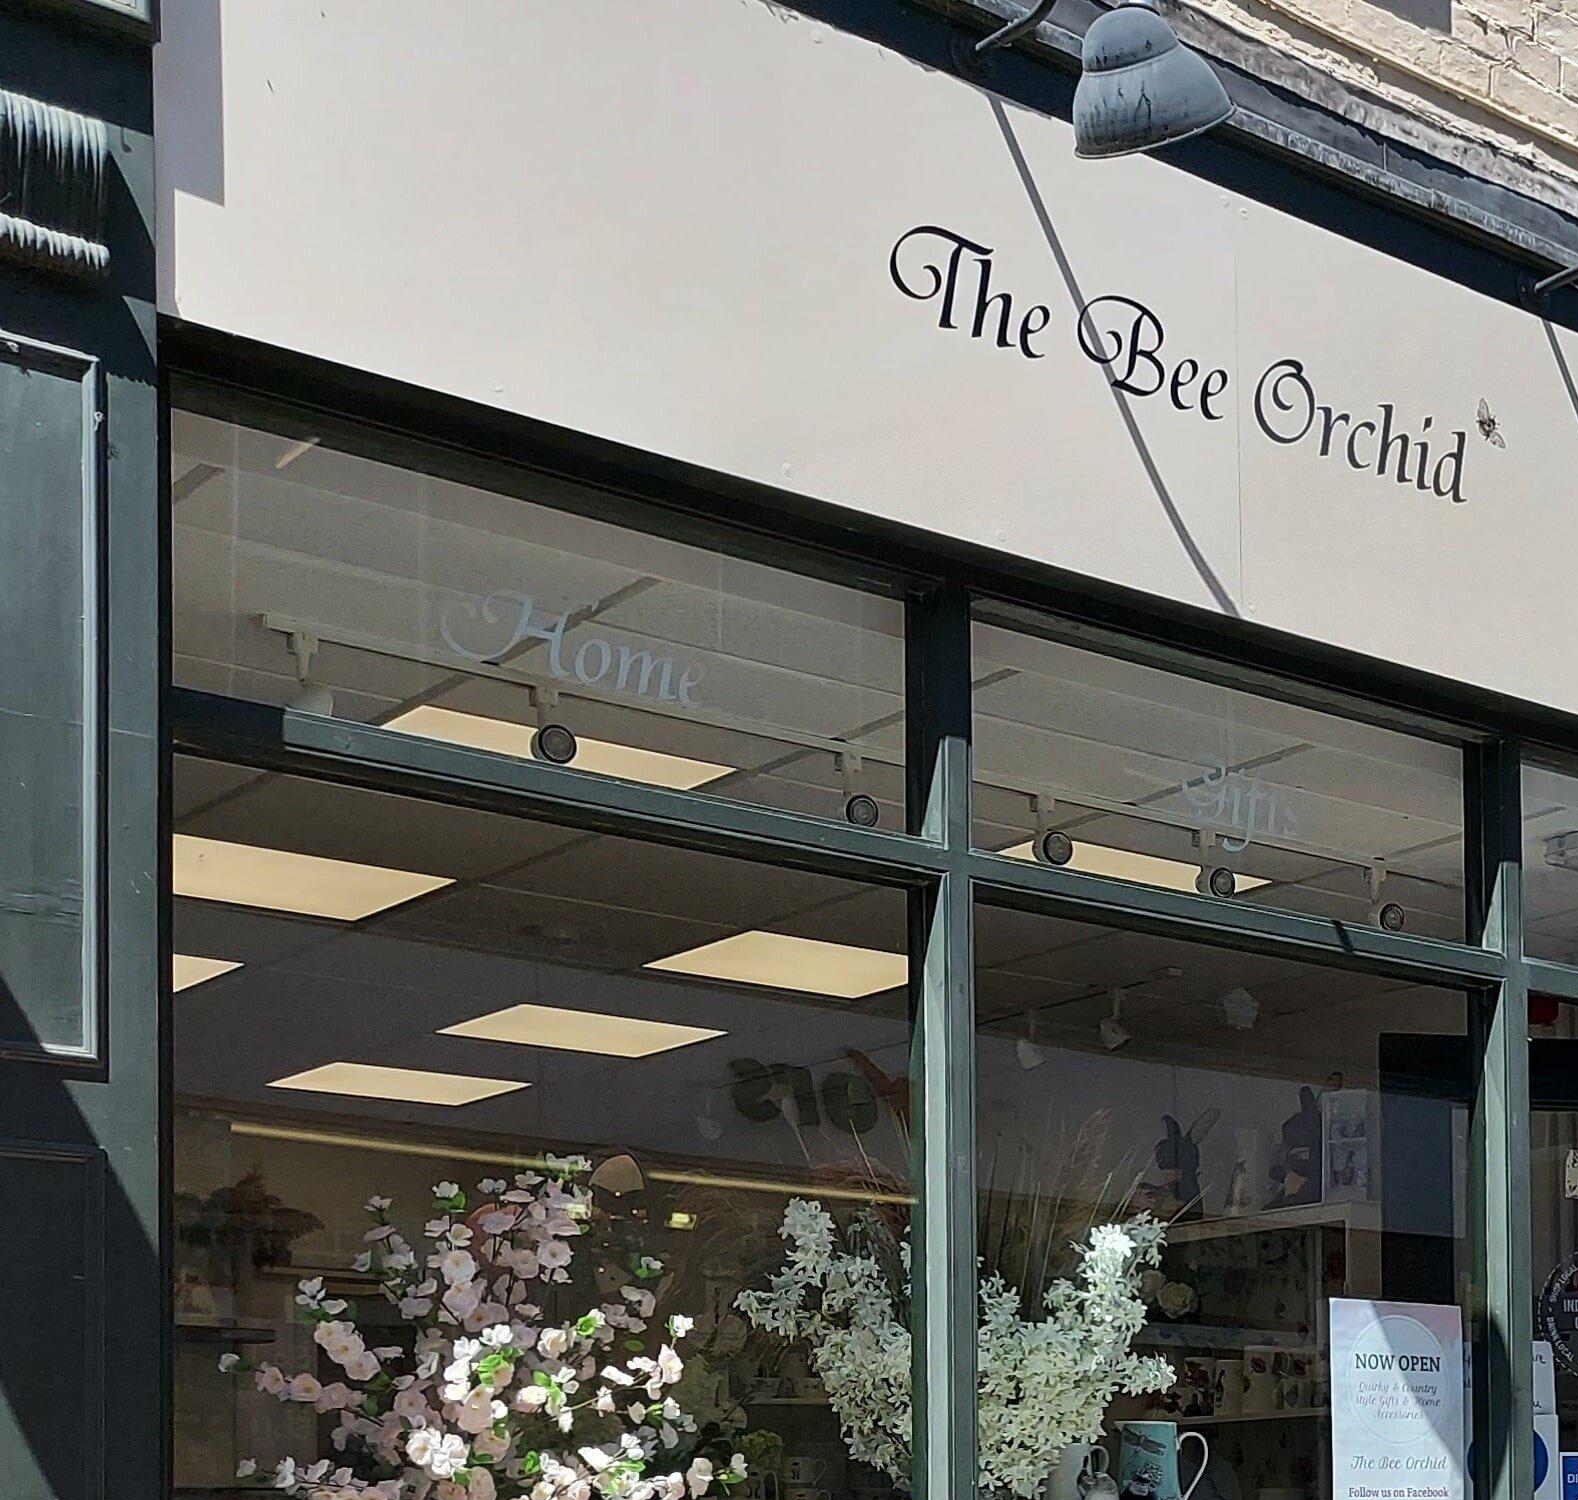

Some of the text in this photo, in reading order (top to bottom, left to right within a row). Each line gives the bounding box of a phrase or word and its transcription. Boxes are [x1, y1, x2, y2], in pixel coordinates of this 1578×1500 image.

[890, 226, 1467, 504] The Bee Orchid
[440, 590, 704, 702] Home
[1355, 1353, 1441, 1373] NOW OPEN
[1358, 1381, 1389, 1395] Quirky
[1401, 1382, 1438, 1396] Country
[1350, 1455, 1448, 1470] The Bee Orchid
[1348, 1487, 1450, 1498] Follow us on Facebook
